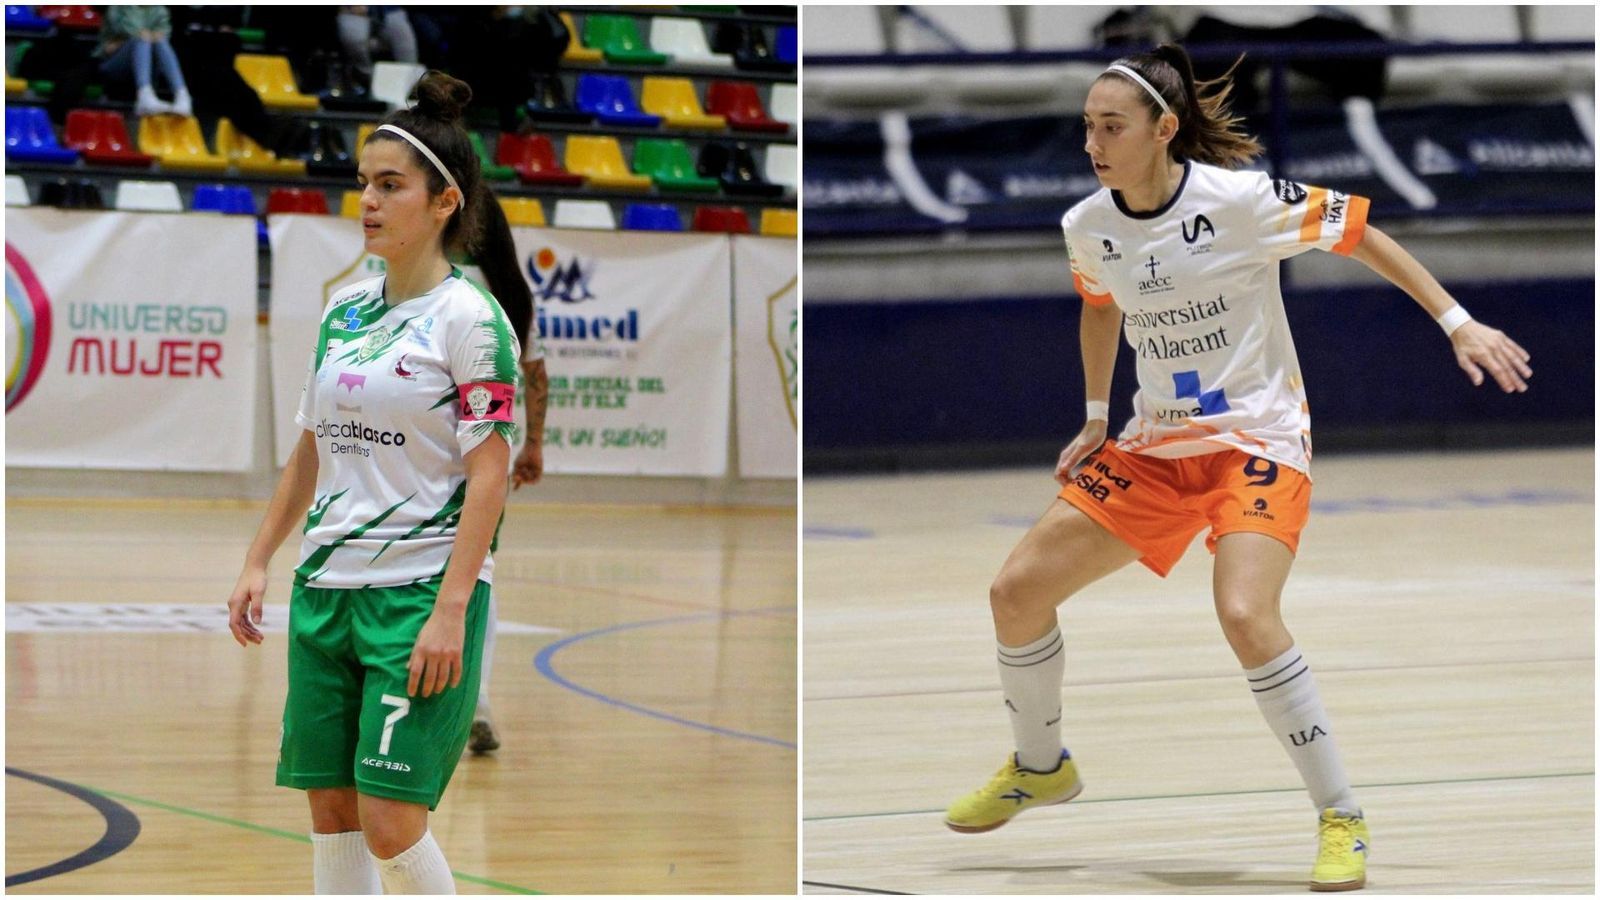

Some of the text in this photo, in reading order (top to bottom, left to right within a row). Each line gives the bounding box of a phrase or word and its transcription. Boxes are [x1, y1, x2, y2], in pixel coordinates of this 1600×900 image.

[1181, 213, 1216, 244] UA
[1138, 275, 1173, 291] aecc
[68, 302, 228, 335] UNIVERSO
[67, 337, 223, 379] MUJER
[637, 377, 665, 393] DEL
[1243, 455, 1279, 487] 9
[1243, 509, 1275, 521] VIATOR
[378, 693, 411, 756] 7
[1289, 725, 1327, 747] UA
[361, 757, 411, 772] ACERBIS
